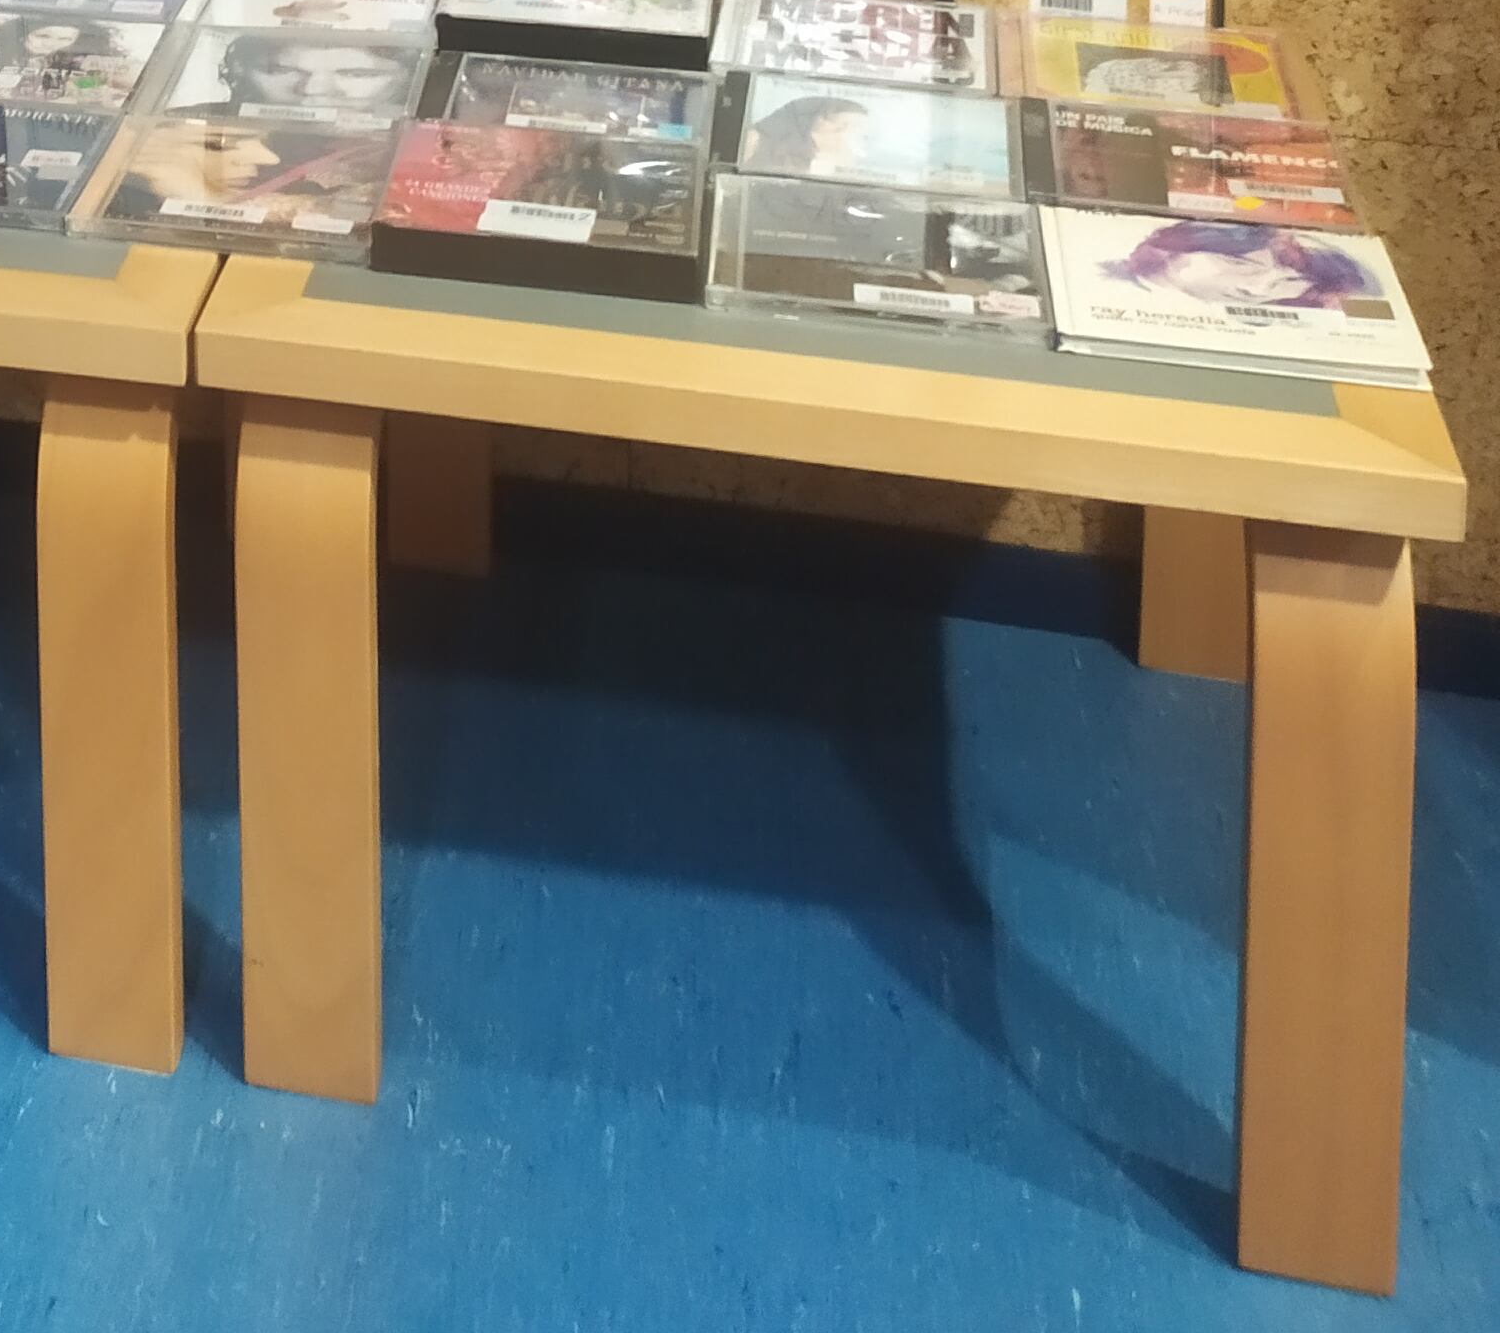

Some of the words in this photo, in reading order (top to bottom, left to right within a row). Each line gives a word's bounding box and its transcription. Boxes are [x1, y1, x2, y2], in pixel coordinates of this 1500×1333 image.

[3, 108, 97, 126] MORENTE
[1054, 111, 1080, 121] UN
[1055, 119, 1079, 129] DE
[1090, 305, 1126, 320] ray
[1136, 307, 1226, 326] heredia
